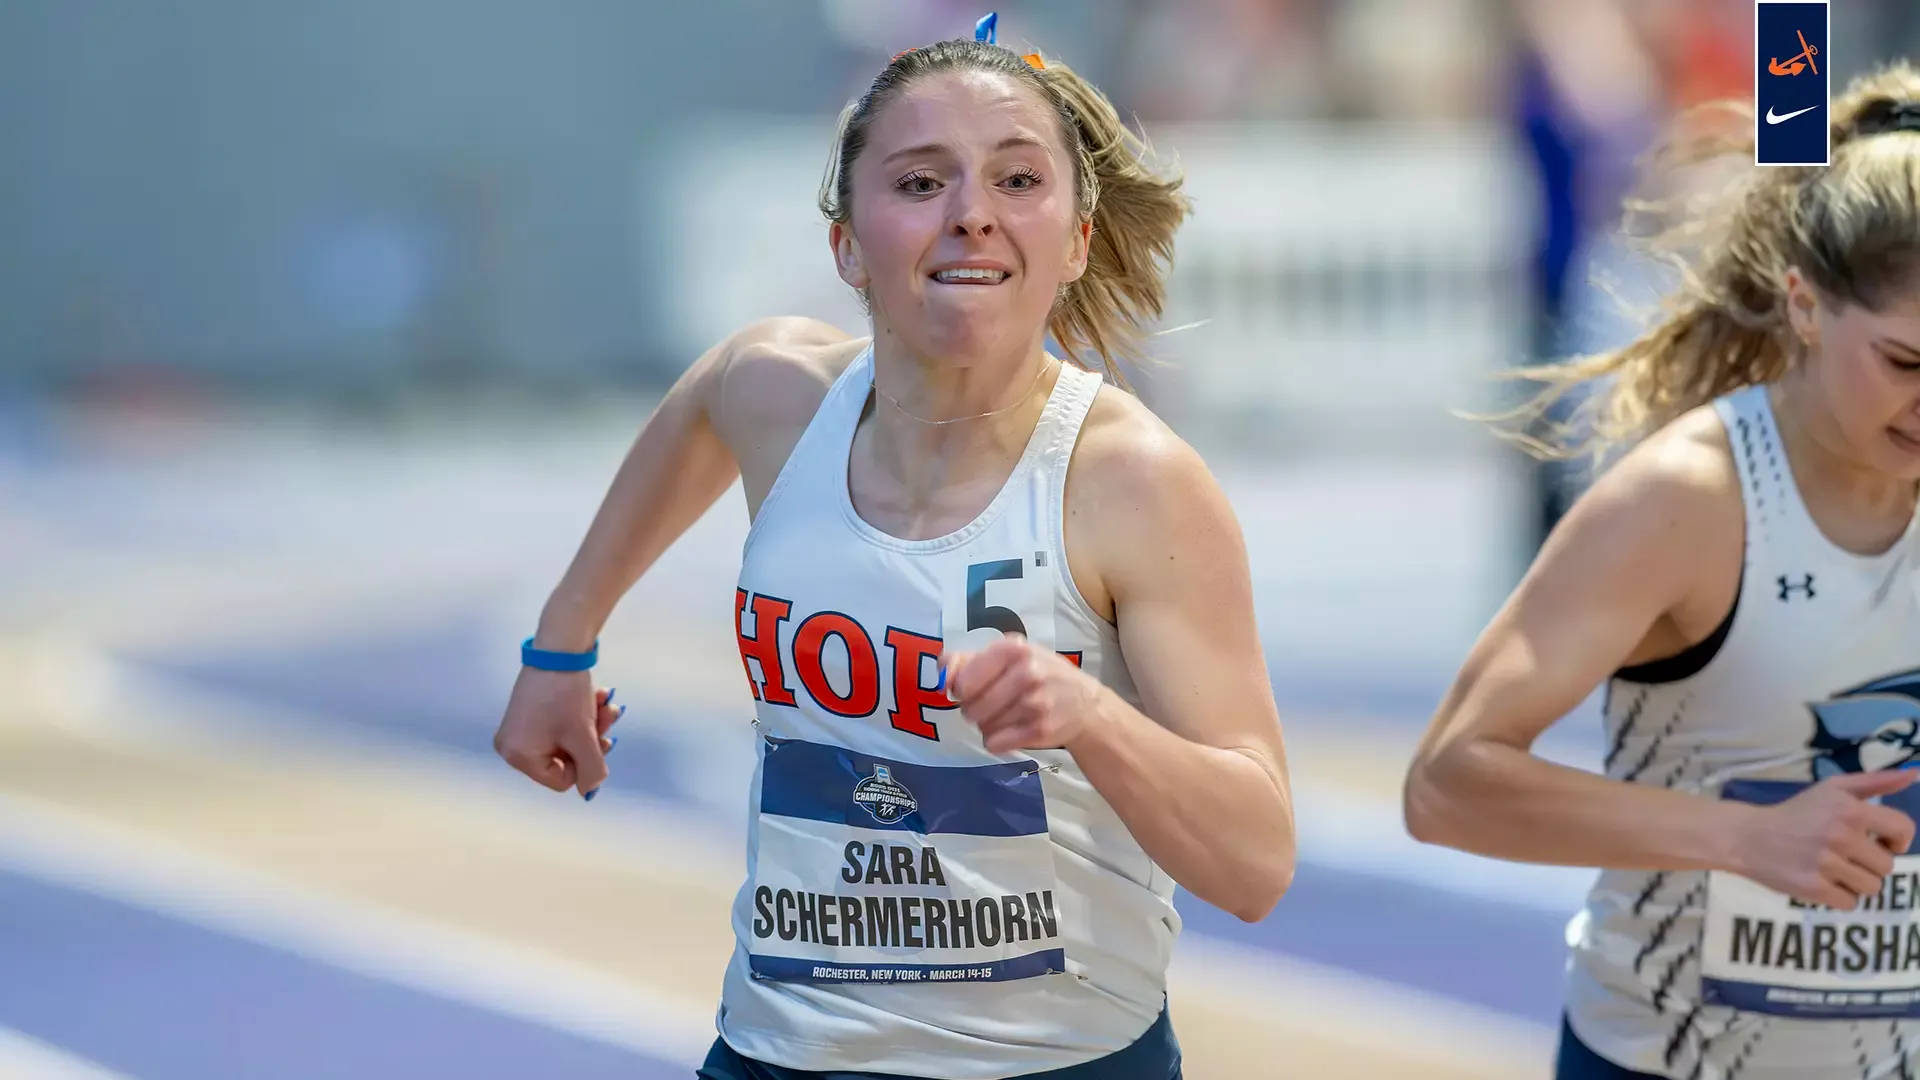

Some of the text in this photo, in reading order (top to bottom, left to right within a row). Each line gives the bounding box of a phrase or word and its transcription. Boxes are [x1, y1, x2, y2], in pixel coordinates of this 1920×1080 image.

[967, 558, 1028, 640] 5
[735, 586, 1083, 741] HOP
[855, 792, 916, 809] CHAMPIONSHIPS
[841, 840, 947, 886] SARA
[753, 886, 1059, 948] SCHERMERHORN
[812, 966, 992, 981] ROCHESTER, NEW YORK MARCH 14-15
